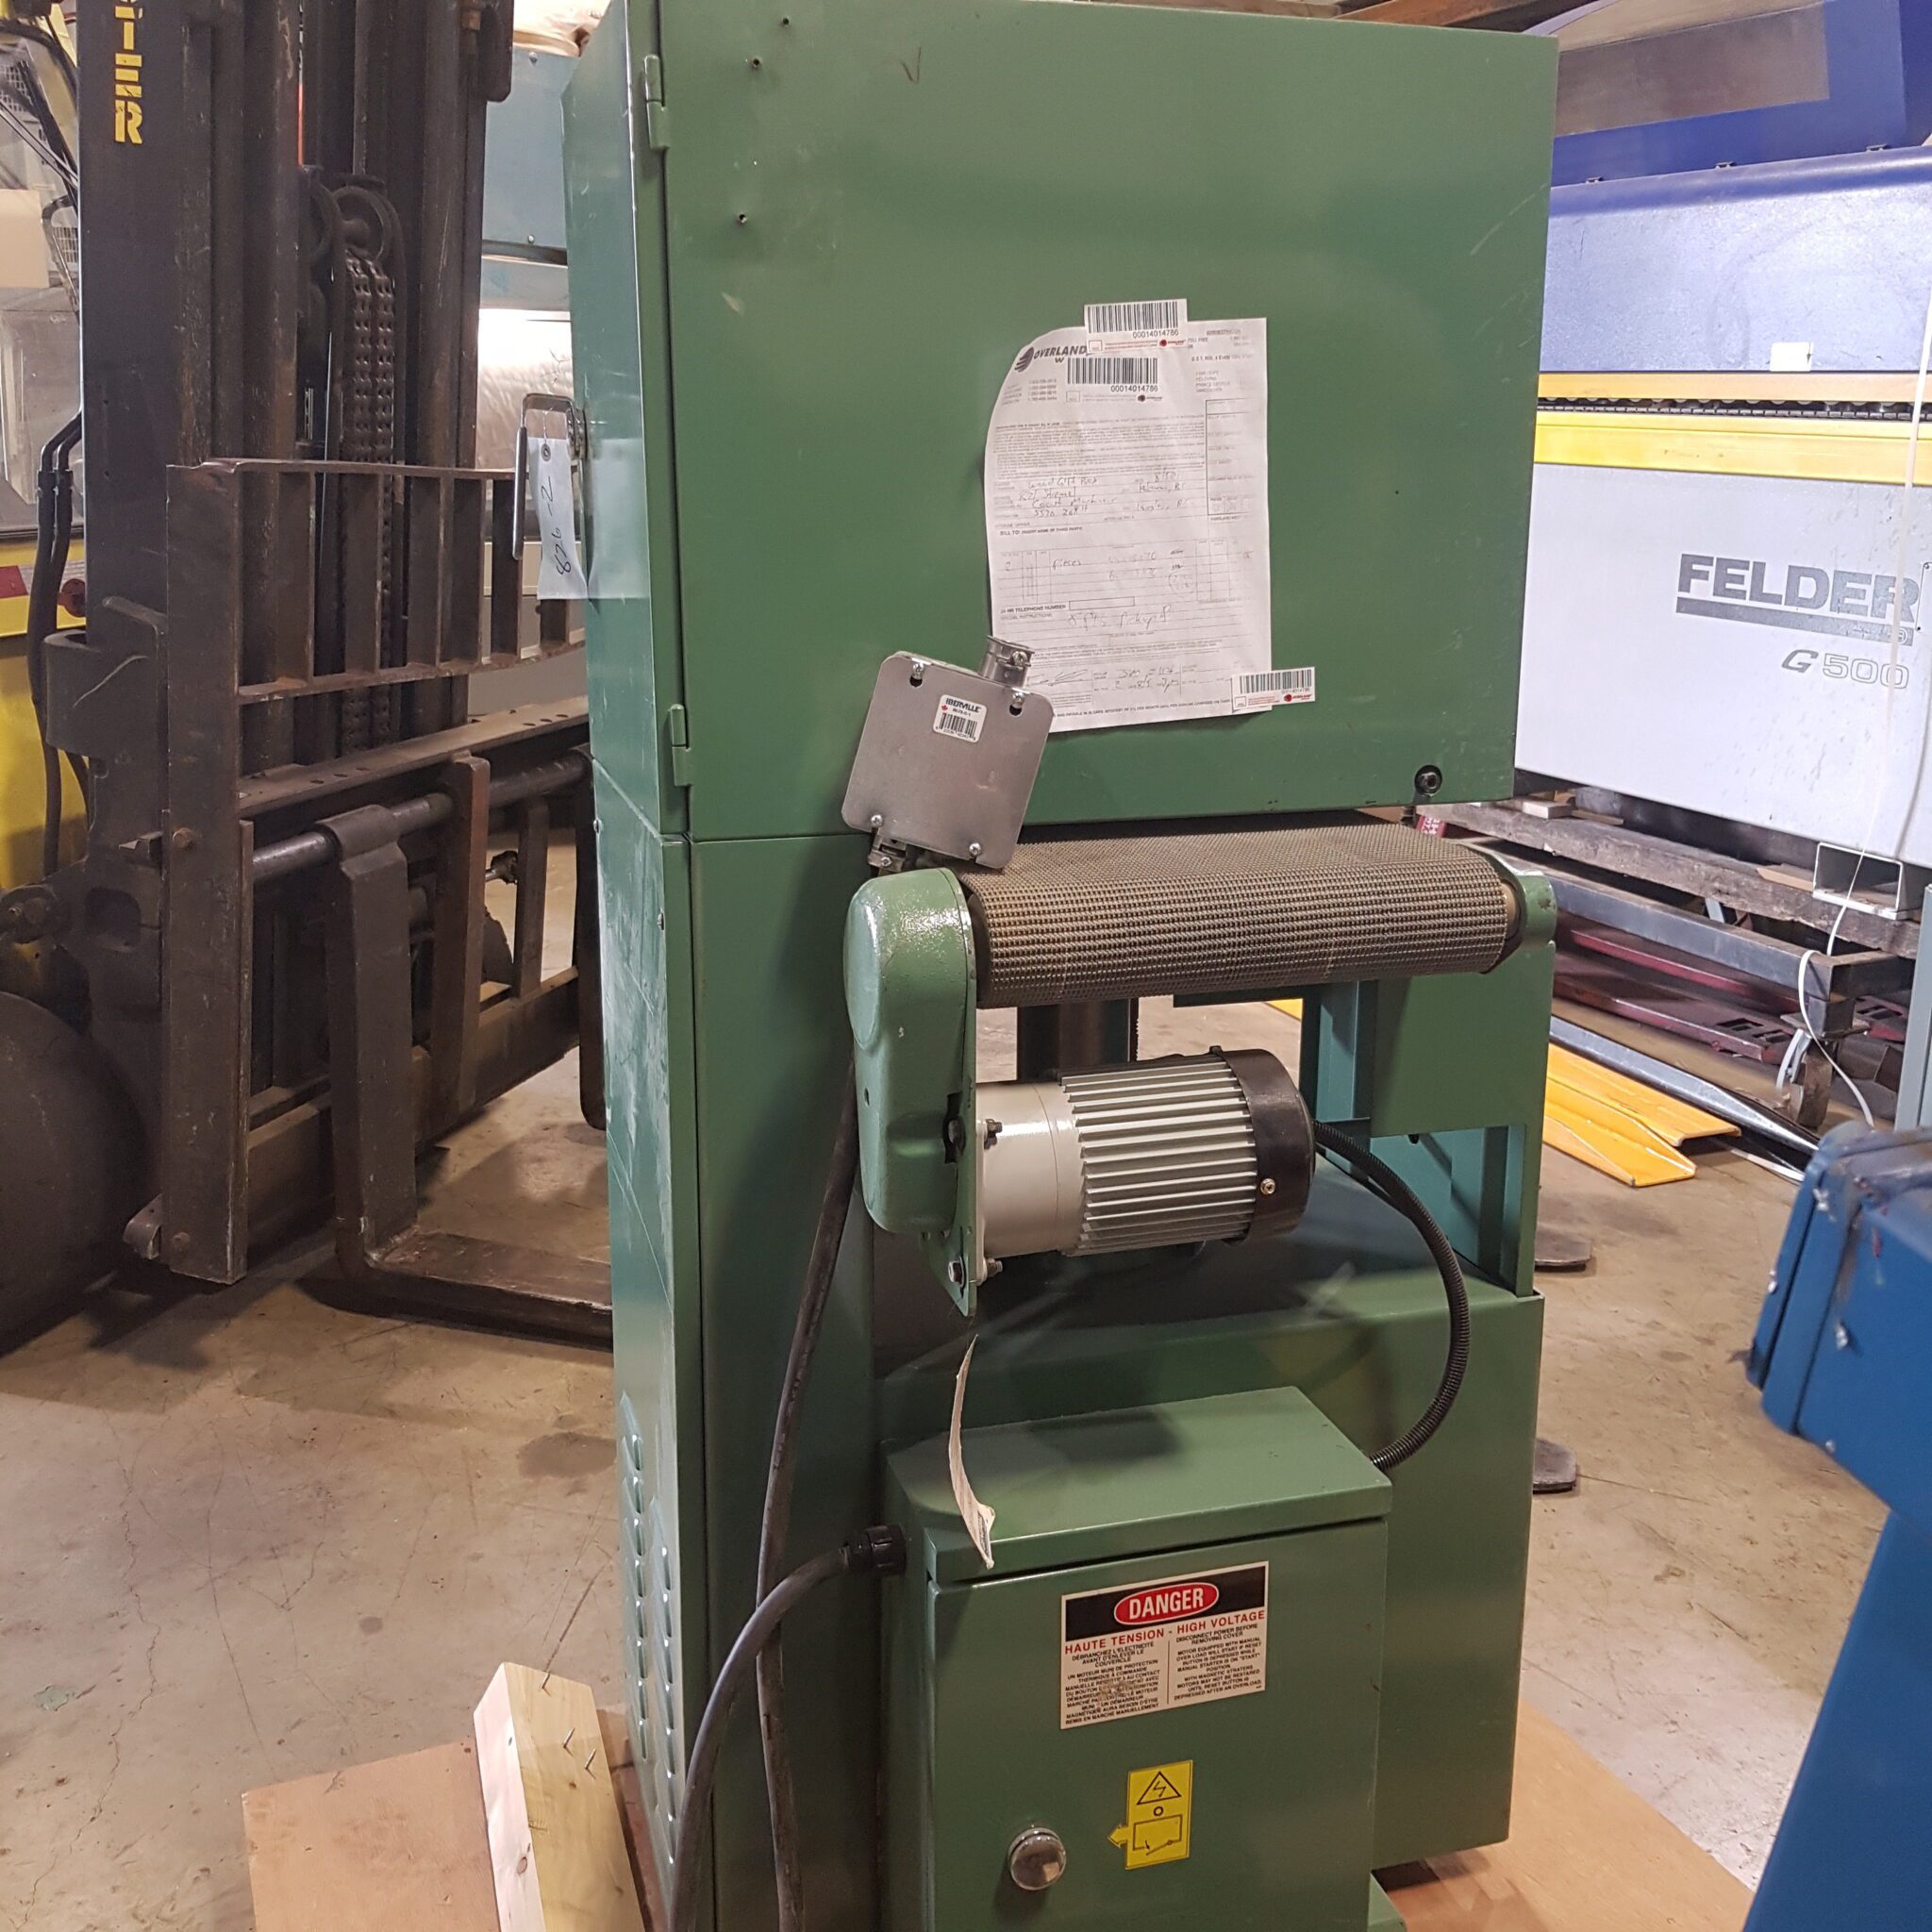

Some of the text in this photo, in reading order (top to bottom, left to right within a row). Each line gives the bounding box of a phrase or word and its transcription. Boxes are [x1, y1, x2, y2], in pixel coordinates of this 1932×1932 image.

[115, 0, 142, 144] TER
[1133, 329, 1178, 338] 00014014786
[1034, 345, 1087, 359] OVERLAND
[1677, 553, 1920, 623] FELDER
[946, 697, 982, 713] IBERVILLE
[1128, 1587, 1204, 1620] DANGER
[1065, 1639, 1106, 1654] HAUTE
[1111, 1628, 1164, 1646] TENSION
[1177, 1621, 1206, 1634] HIGH
[1211, 1610, 1265, 1628] VOLTAGE
[1176, 1632, 1212, 1642] DISCONNECT
[1236, 1624, 1257, 1632] BEFORE
[1191, 1636, 1222, 1644] REMOVING
[1198, 1643, 1224, 1652] EQUIPPED
[1210, 1652, 1239, 1660] DEPRESSED
[1095, 1657, 1131, 1668] COUVERCLE
[1124, 1659, 1158, 1670] PROTECTION
[1066, 1682, 1094, 1691] MANUELLE
[1136, 1670, 1159, 1678] CONTACT
[1079, 1674, 1109, 1683] THERMIQUE
[1117, 1667, 1147, 1676] COMMANDE
[1199, 1671, 1224, 1679] MAGNETIC
[1174, 1690, 1205, 1700] DEPRESSED
[1116, 1704, 1158, 1715] MANUELLEMENT
